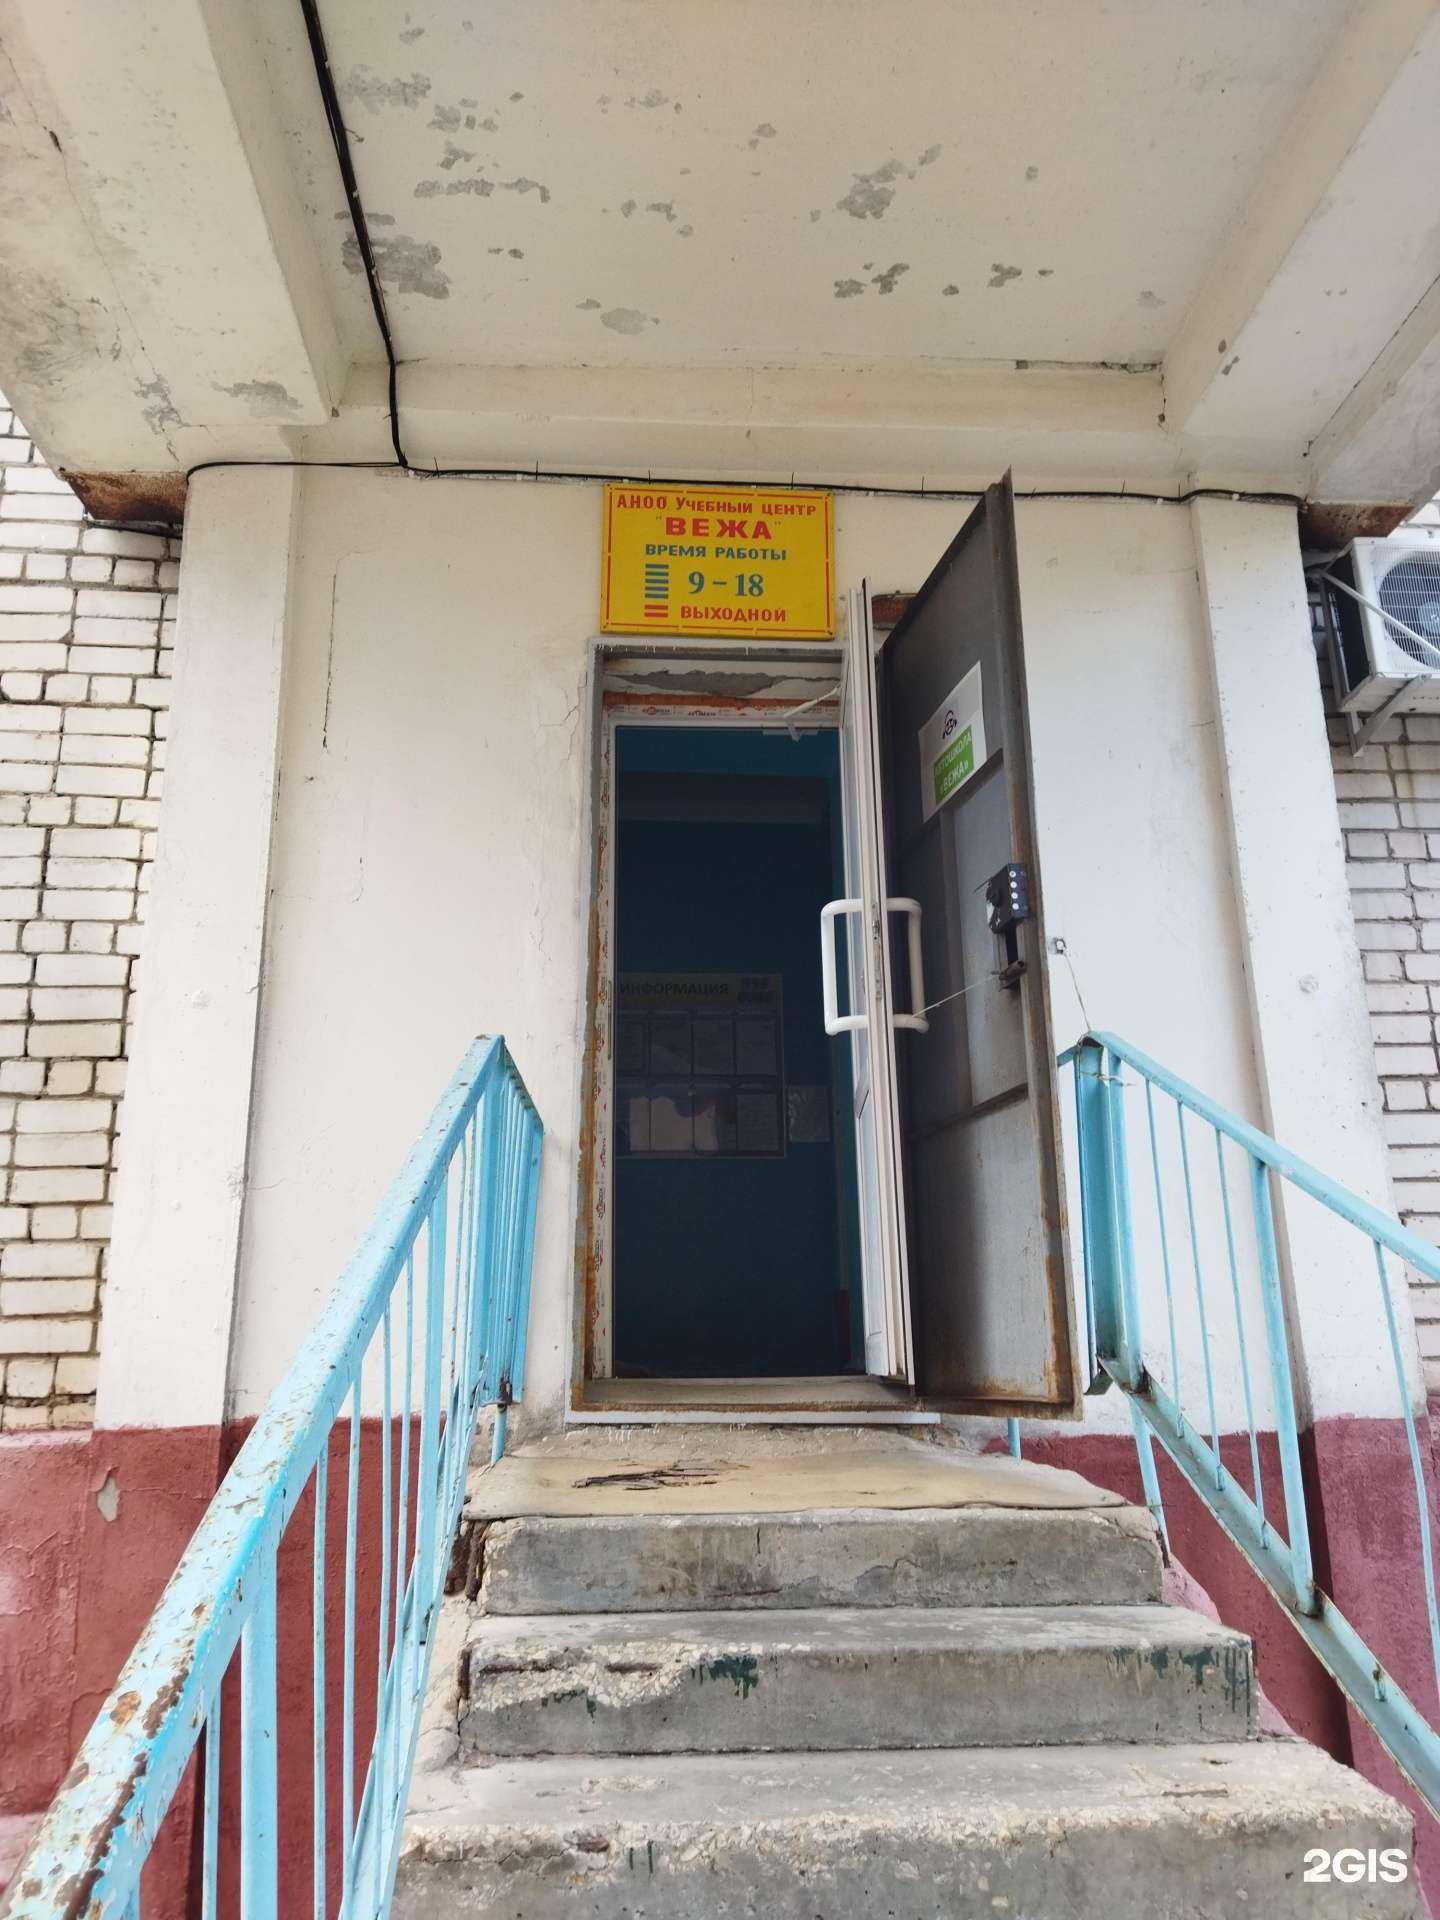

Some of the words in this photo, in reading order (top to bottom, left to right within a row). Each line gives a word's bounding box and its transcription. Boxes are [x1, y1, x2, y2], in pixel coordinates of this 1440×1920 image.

[617, 494, 668, 510] АНОО
[762, 503, 817, 517] ЦЕНТР
[645, 543, 707, 558] ВРЕМЯ
[715, 547, 787, 561] РАБОТЫ
[680, 605, 787, 623] ВЫХОДНОЙ
[620, 982, 729, 998] ИНФОРМАЦИЯ
